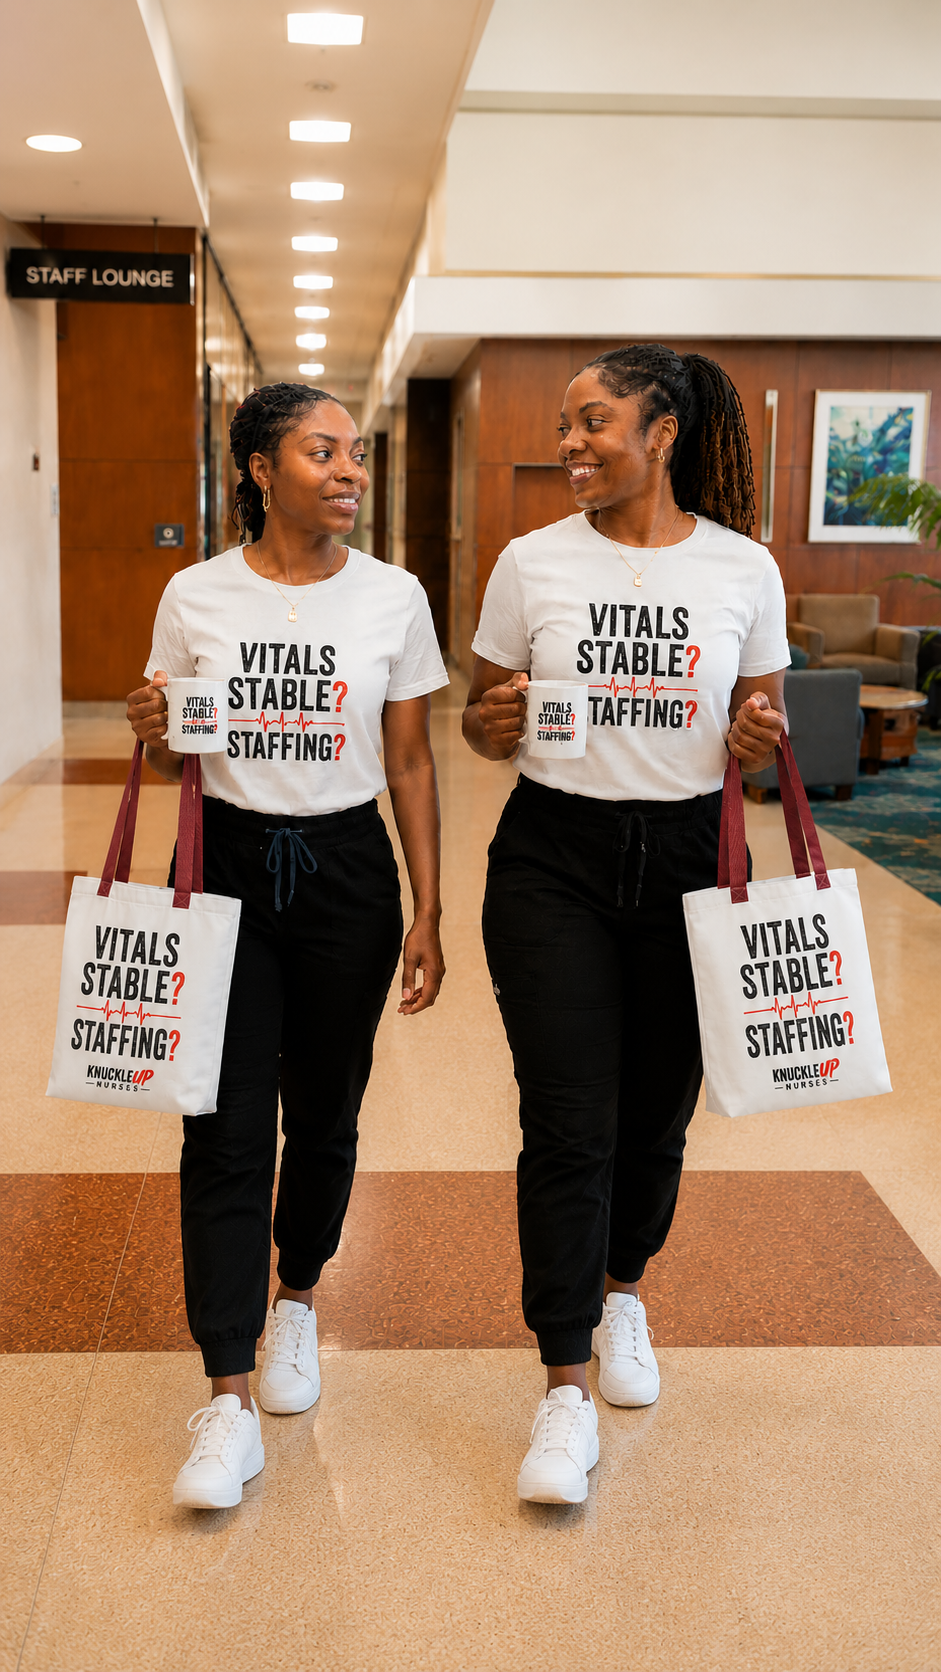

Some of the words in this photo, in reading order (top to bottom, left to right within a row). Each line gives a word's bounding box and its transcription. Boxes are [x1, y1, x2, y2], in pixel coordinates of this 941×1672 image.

[26, 266, 87, 285] STAFF
[92, 268, 174, 288] LOUNGE
[588, 603, 689, 640] VITALS
[239, 641, 336, 676] VITALS
[577, 639, 701, 678] STABLE?
[186, 696, 214, 708] VITALS
[228, 677, 348, 712] STABLE?
[542, 701, 572, 714] VITALS
[181, 723, 218, 735] STAFFING?
[182, 707, 218, 719] STABLE?
[538, 713, 576, 725] STABLE?
[587, 696, 698, 729] TAFFING?
[227, 729, 346, 762] STAFFING?
[537, 730, 575, 742] STAFFING?
[95, 925, 180, 968] VITALS
[740, 913, 829, 959] VITALS
[81, 962, 186, 1005] STABLE?
[740, 950, 843, 1000] STABLE?
[71, 1018, 181, 1062] STAFFING?
[745, 1011, 855, 1059] STAFFING?
[96, 1081, 139, 1092] NURSES
[785, 1078, 828, 1091] NURSES
